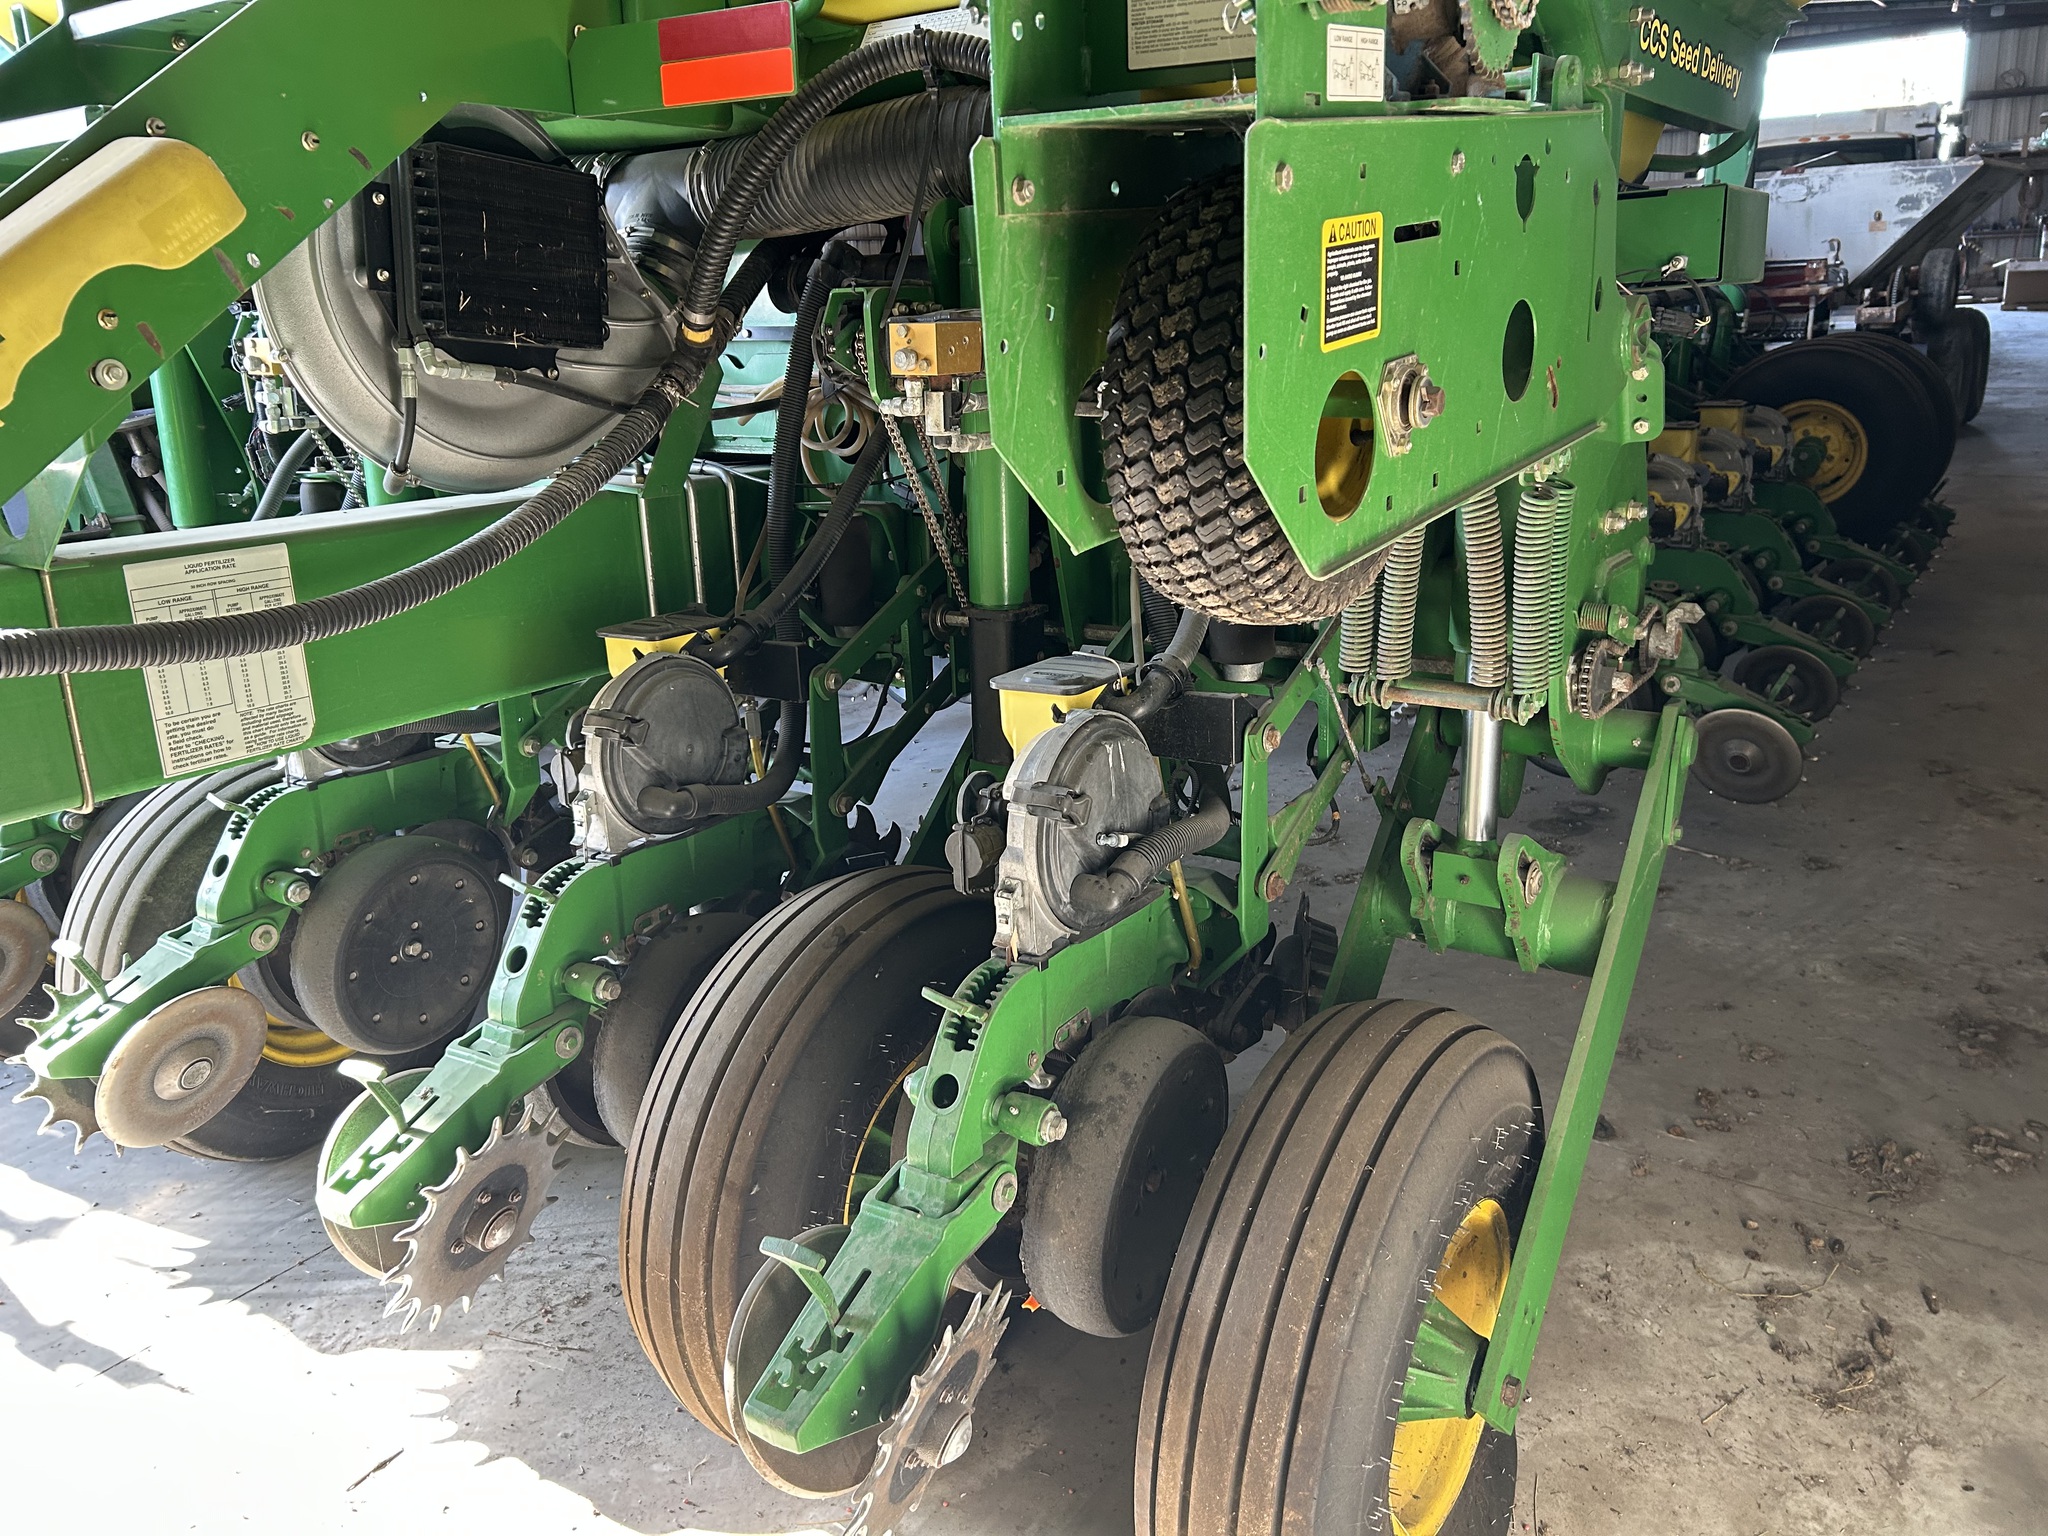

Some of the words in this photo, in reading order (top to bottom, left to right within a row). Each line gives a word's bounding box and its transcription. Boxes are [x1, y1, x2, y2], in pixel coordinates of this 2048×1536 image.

[1640, 18, 1669, 59] CCS
[1670, 30, 1701, 74] Seed
[1701, 46, 1742, 98] Delivery
[1338, 218, 1376, 241] CAUTION
[204, 558, 235, 566] FERTILIZER
[185, 566, 221, 575] APPLICATION
[179, 606, 206, 614] APPROXIMATE
[166, 726, 185, 735] getting
[196, 719, 216, 727] desired
[192, 735, 224, 746] "CHECKING
[170, 746, 203, 758] FERTILIZER
[205, 741, 225, 749] RATES"
[172, 752, 204, 764] instructions
[190, 757, 212, 765] fertilizer
